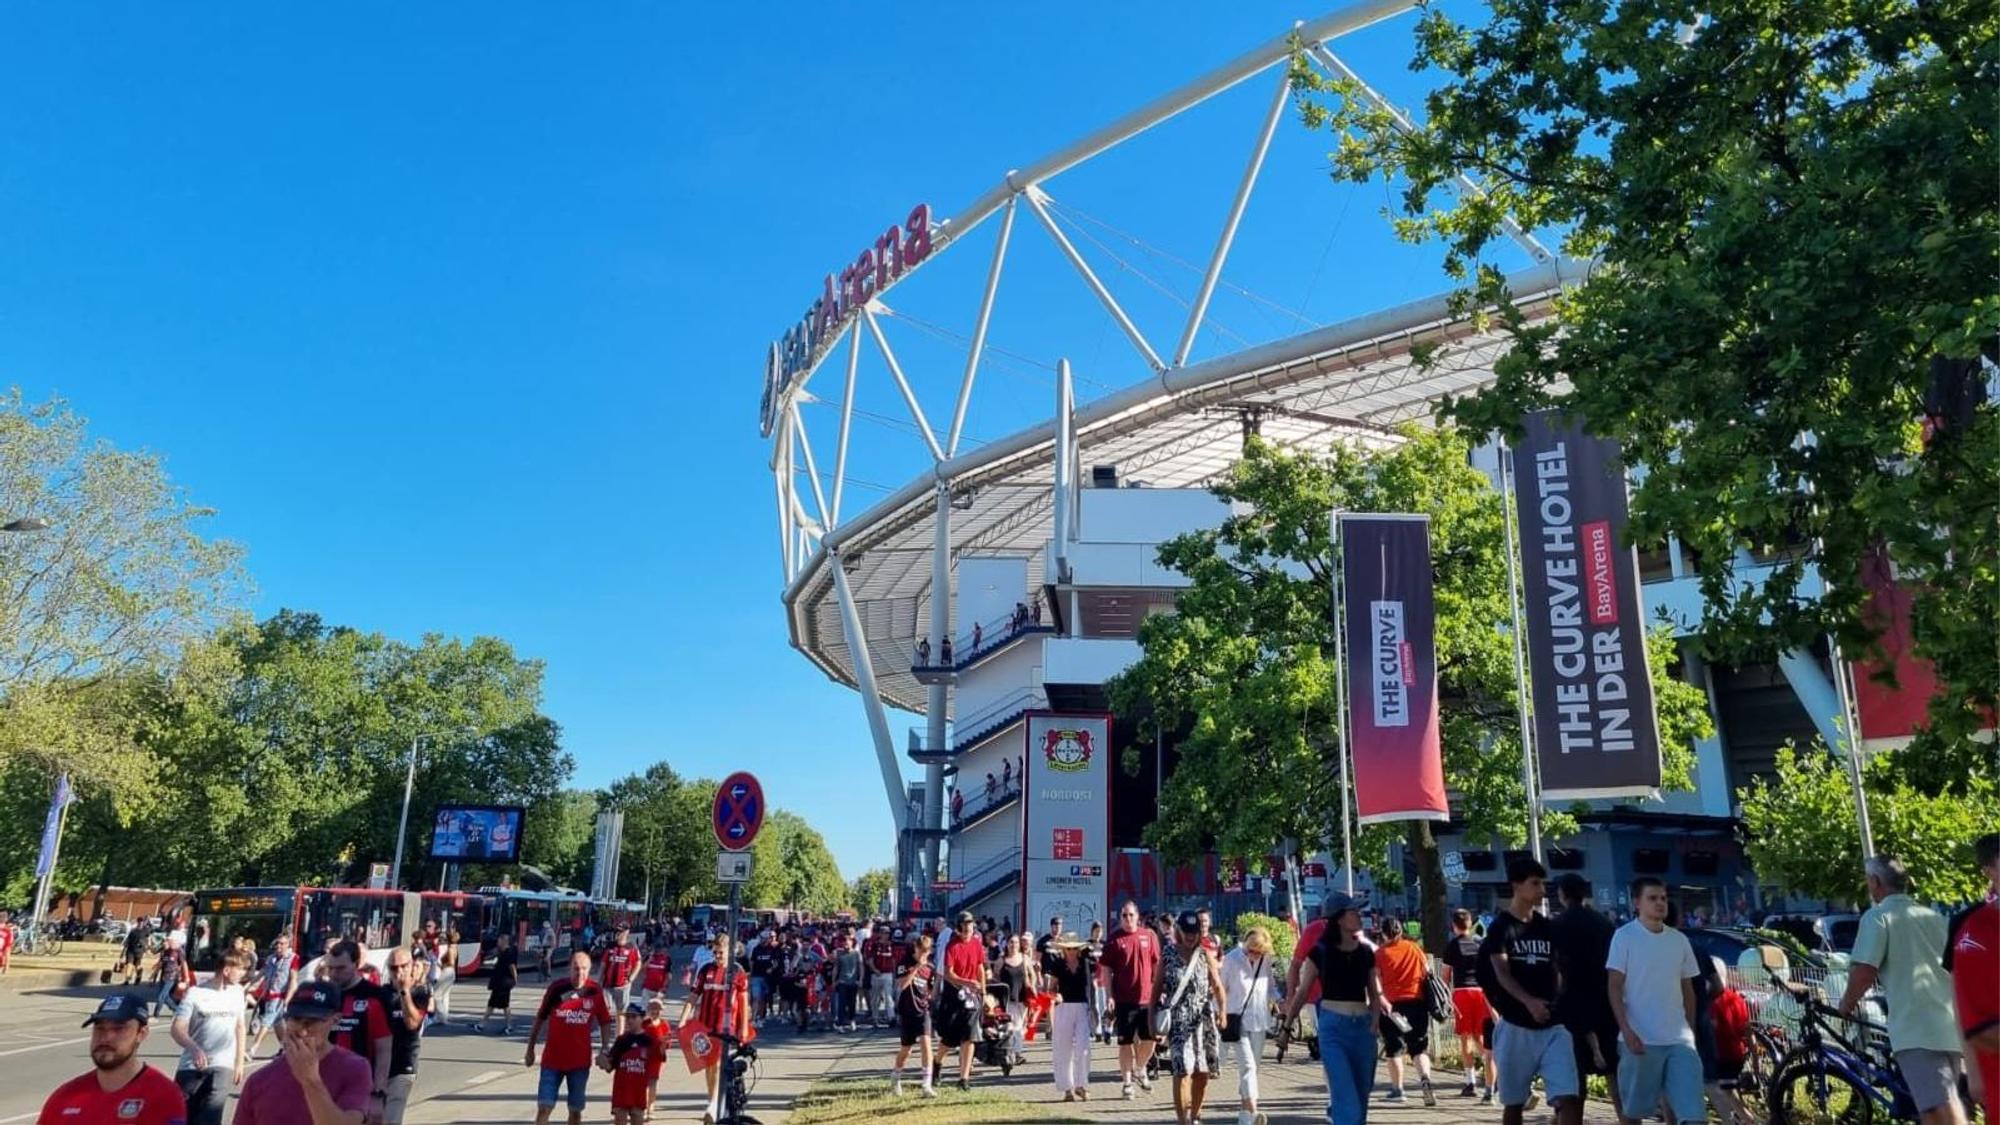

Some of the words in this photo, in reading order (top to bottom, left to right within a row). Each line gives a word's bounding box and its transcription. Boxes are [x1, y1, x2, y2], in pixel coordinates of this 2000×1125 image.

[1536, 442, 1575, 552] HOTEL
[1592, 528, 1613, 617] BayArena
[1379, 608, 1399, 676] CURVE
[1545, 559, 1587, 677] CURVE
[1592, 626, 1628, 701] DER
[1382, 680, 1400, 718] THE
[1557, 684, 1594, 754] THE
[1599, 709, 1634, 751] IN
[1512, 939, 1551, 954] AMIRI
